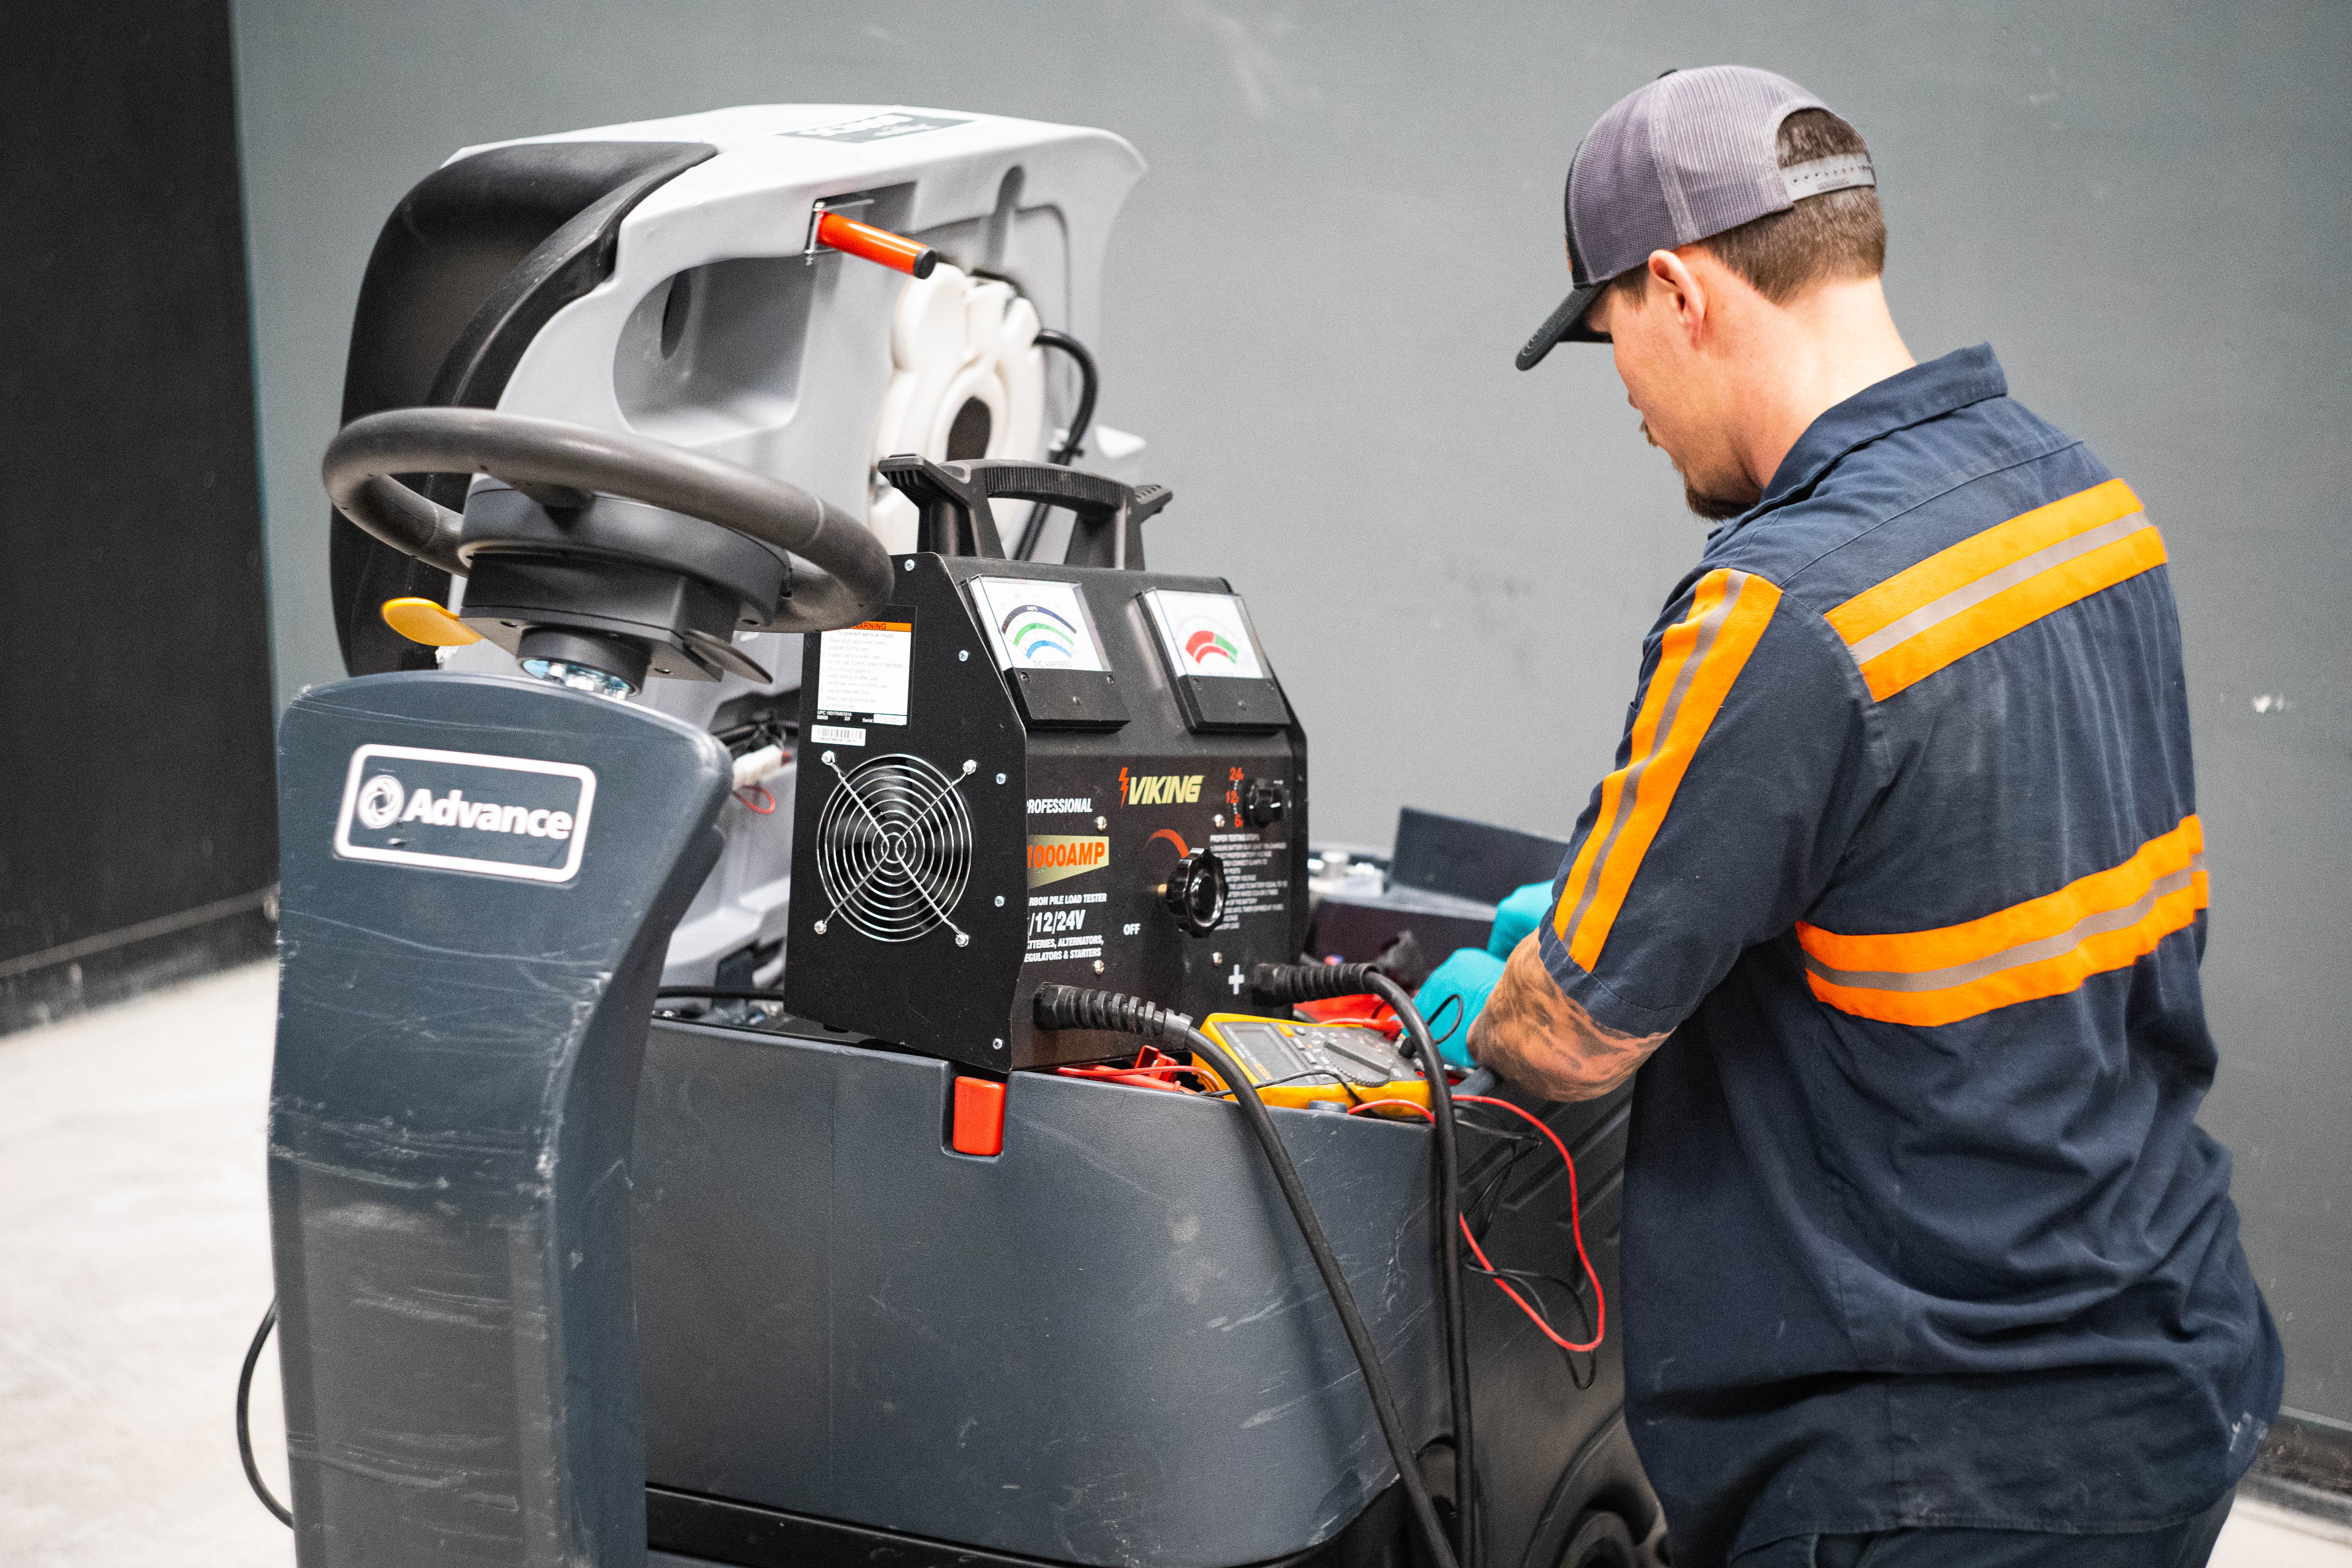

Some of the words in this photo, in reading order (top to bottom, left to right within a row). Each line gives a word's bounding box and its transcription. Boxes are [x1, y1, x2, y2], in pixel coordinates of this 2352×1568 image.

[851, 621, 886, 630] ARNING
[1129, 775, 1205, 805] VIKING
[400, 788, 573, 840] Advance
[1027, 842, 1105, 869] 1000AMP
[1029, 897, 1049, 906] RBON
[1049, 895, 1064, 905] PILE
[1065, 894, 1082, 904] LOAD
[1083, 893, 1107, 903] TESTER
[1029, 909, 1086, 936] /12/24V
[1123, 923, 1140, 936] OFF
[1027, 938, 1057, 949] TTERIES,
[1057, 935, 1104, 947] ALTERNATORS,
[1024, 951, 1062, 963] EGULATORS
[1063, 950, 1069, 960] &
[1069, 947, 1102, 959] STARTERS
